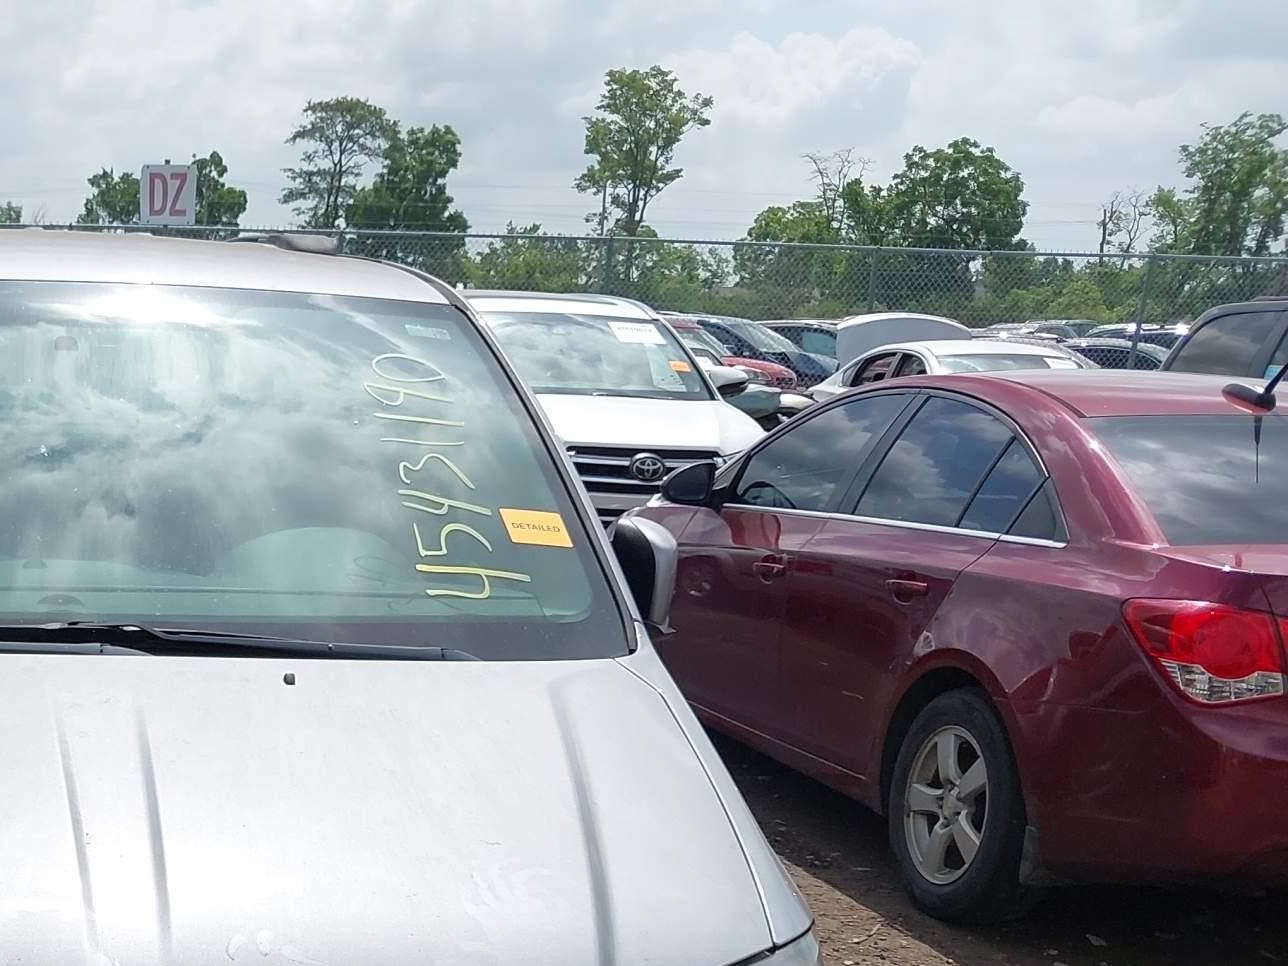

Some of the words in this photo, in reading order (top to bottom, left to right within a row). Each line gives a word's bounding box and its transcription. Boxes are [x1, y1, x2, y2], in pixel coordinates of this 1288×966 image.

[149, 172, 188, 217] DZ
[362, 352, 532, 599] 45431190
[511, 522, 561, 533] DETAILED
